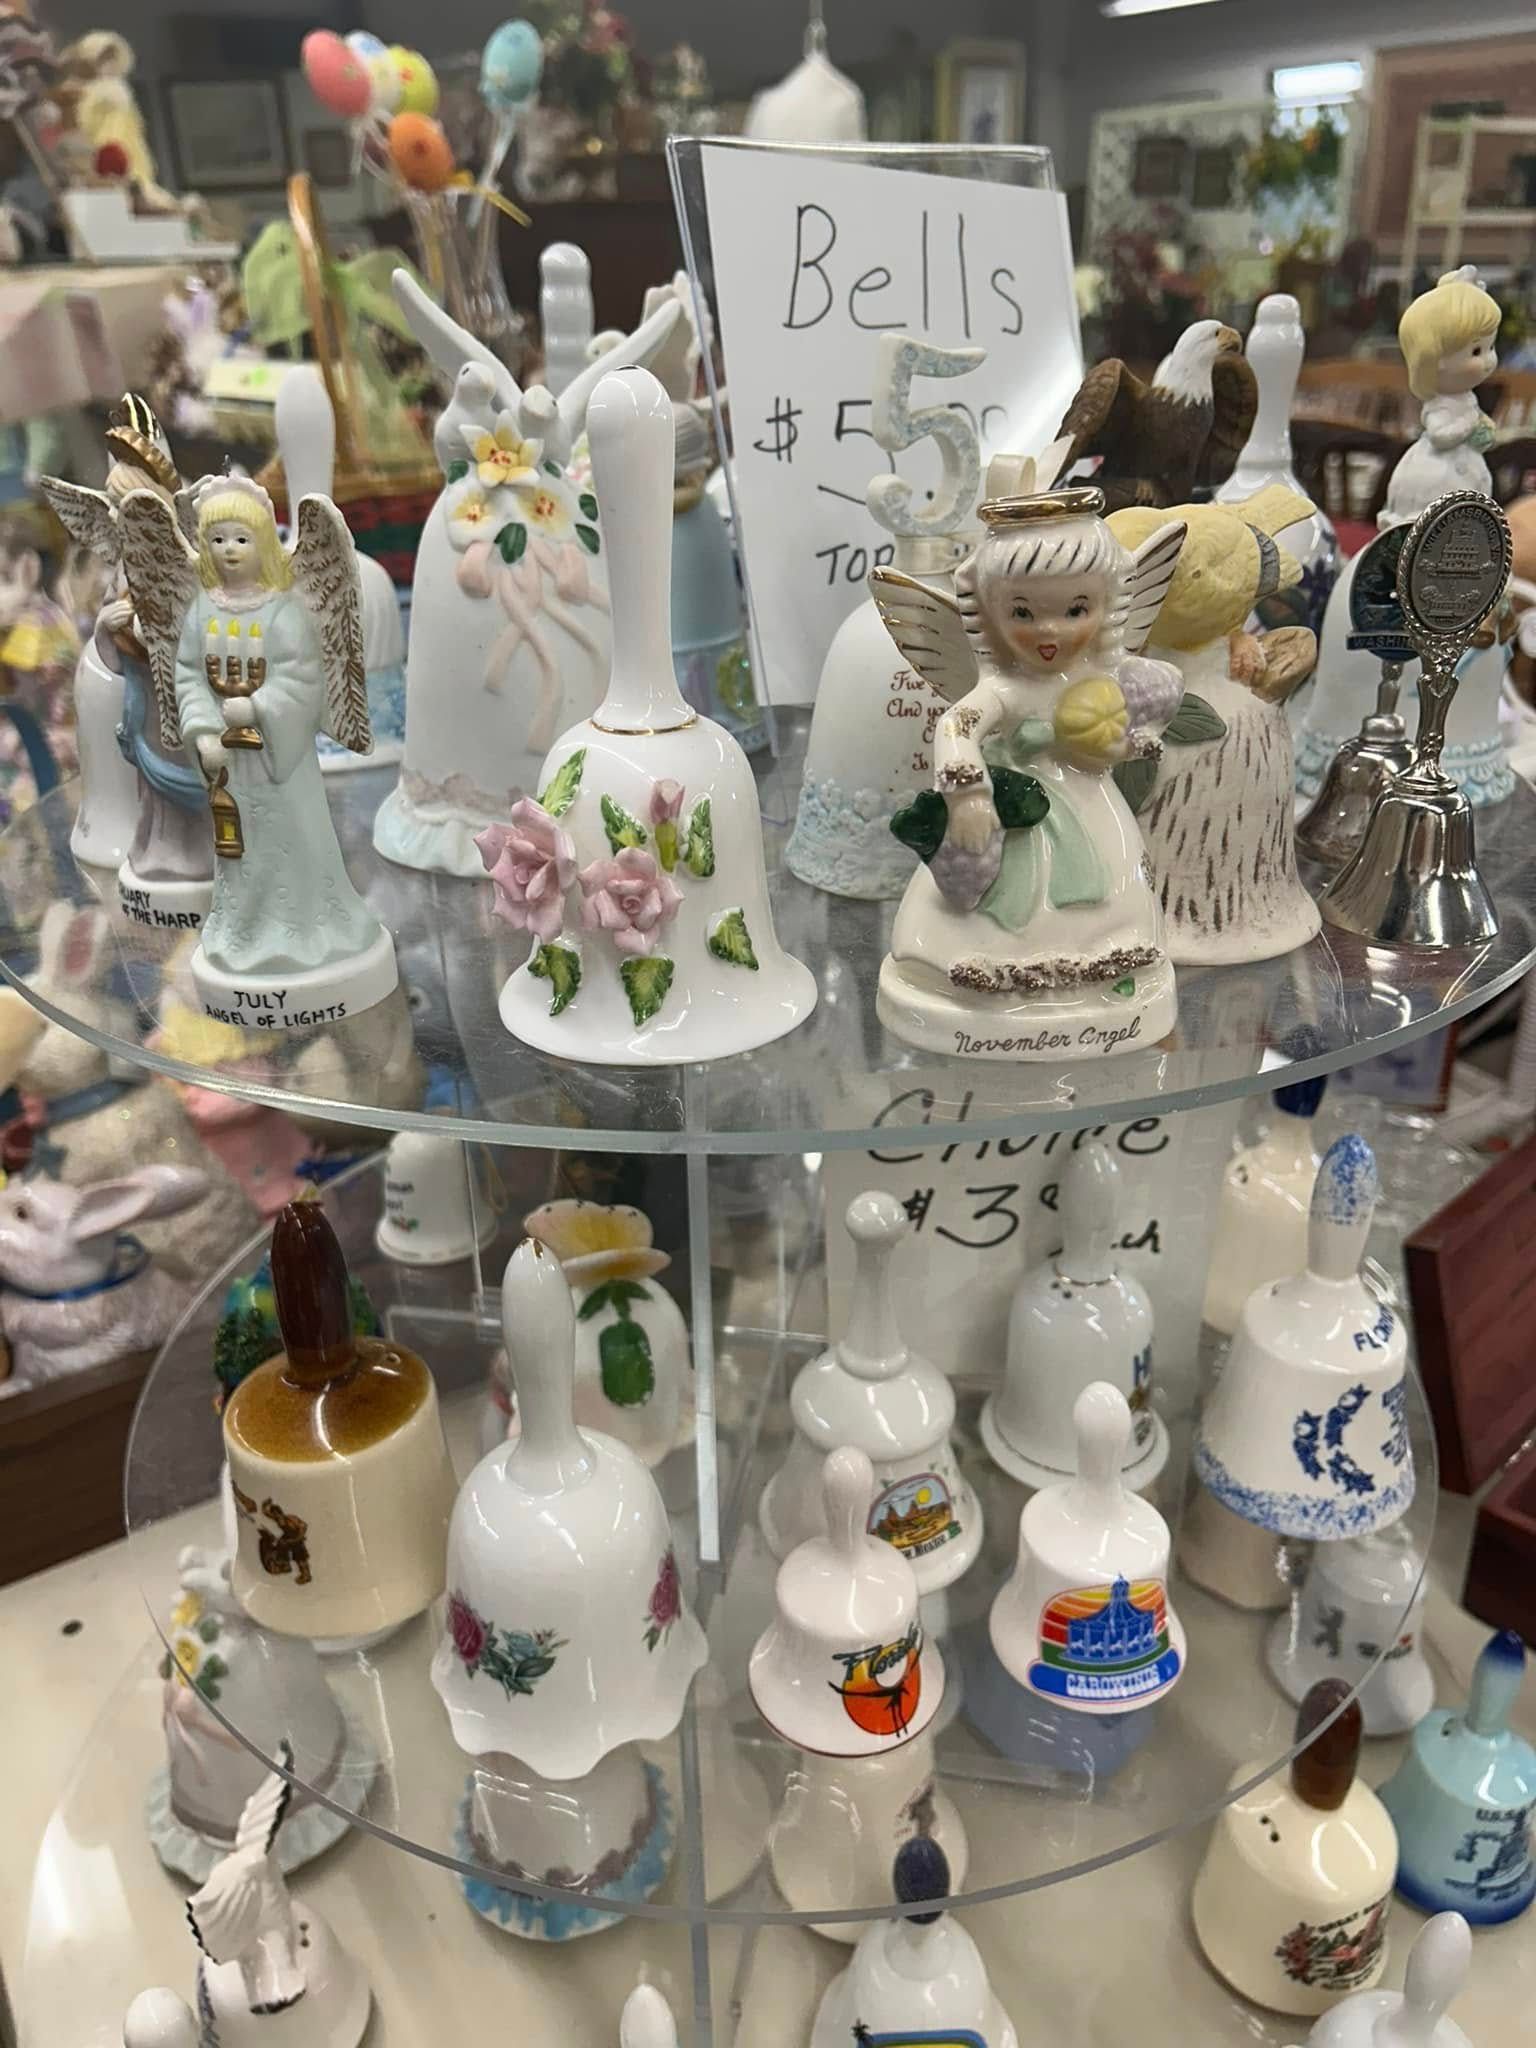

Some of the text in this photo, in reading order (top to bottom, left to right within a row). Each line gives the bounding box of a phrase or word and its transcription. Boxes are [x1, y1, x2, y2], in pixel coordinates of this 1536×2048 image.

[782, 204, 1023, 339] Bells
[887, 697, 922, 718] And
[131, 906, 152, 925] THE
[153, 909, 201, 928] HARP
[233, 990, 288, 1009] JULY
[205, 1003, 347, 1028] ANGEL OF LIGHTS
[954, 1016, 1142, 1054] November Angel
